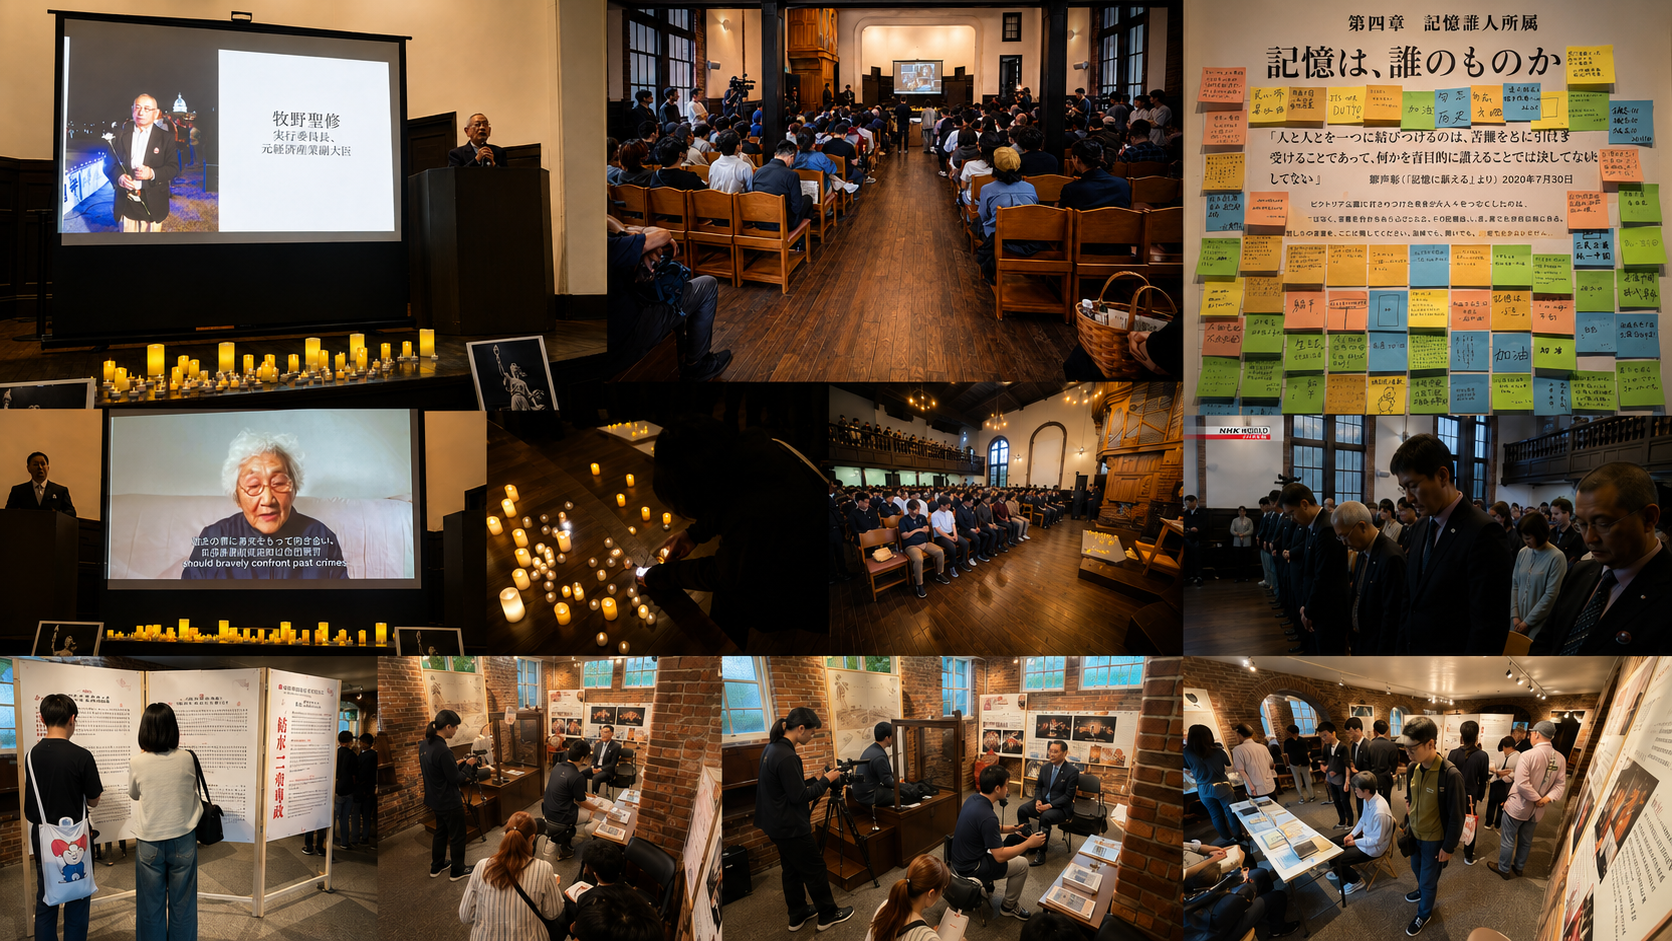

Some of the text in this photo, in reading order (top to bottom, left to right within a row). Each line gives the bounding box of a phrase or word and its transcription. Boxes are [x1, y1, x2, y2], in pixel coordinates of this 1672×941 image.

[1348, 14, 1539, 32] 第四章 記憶誰人所属
[1266, 45, 1561, 79] 記憶は、誰のものか
[272, 110, 341, 129] 牧野聖修
[216, 559, 249, 569] bravely
[251, 559, 292, 568] confront
[293, 560, 313, 569] past
[315, 558, 347, 567] crimes
